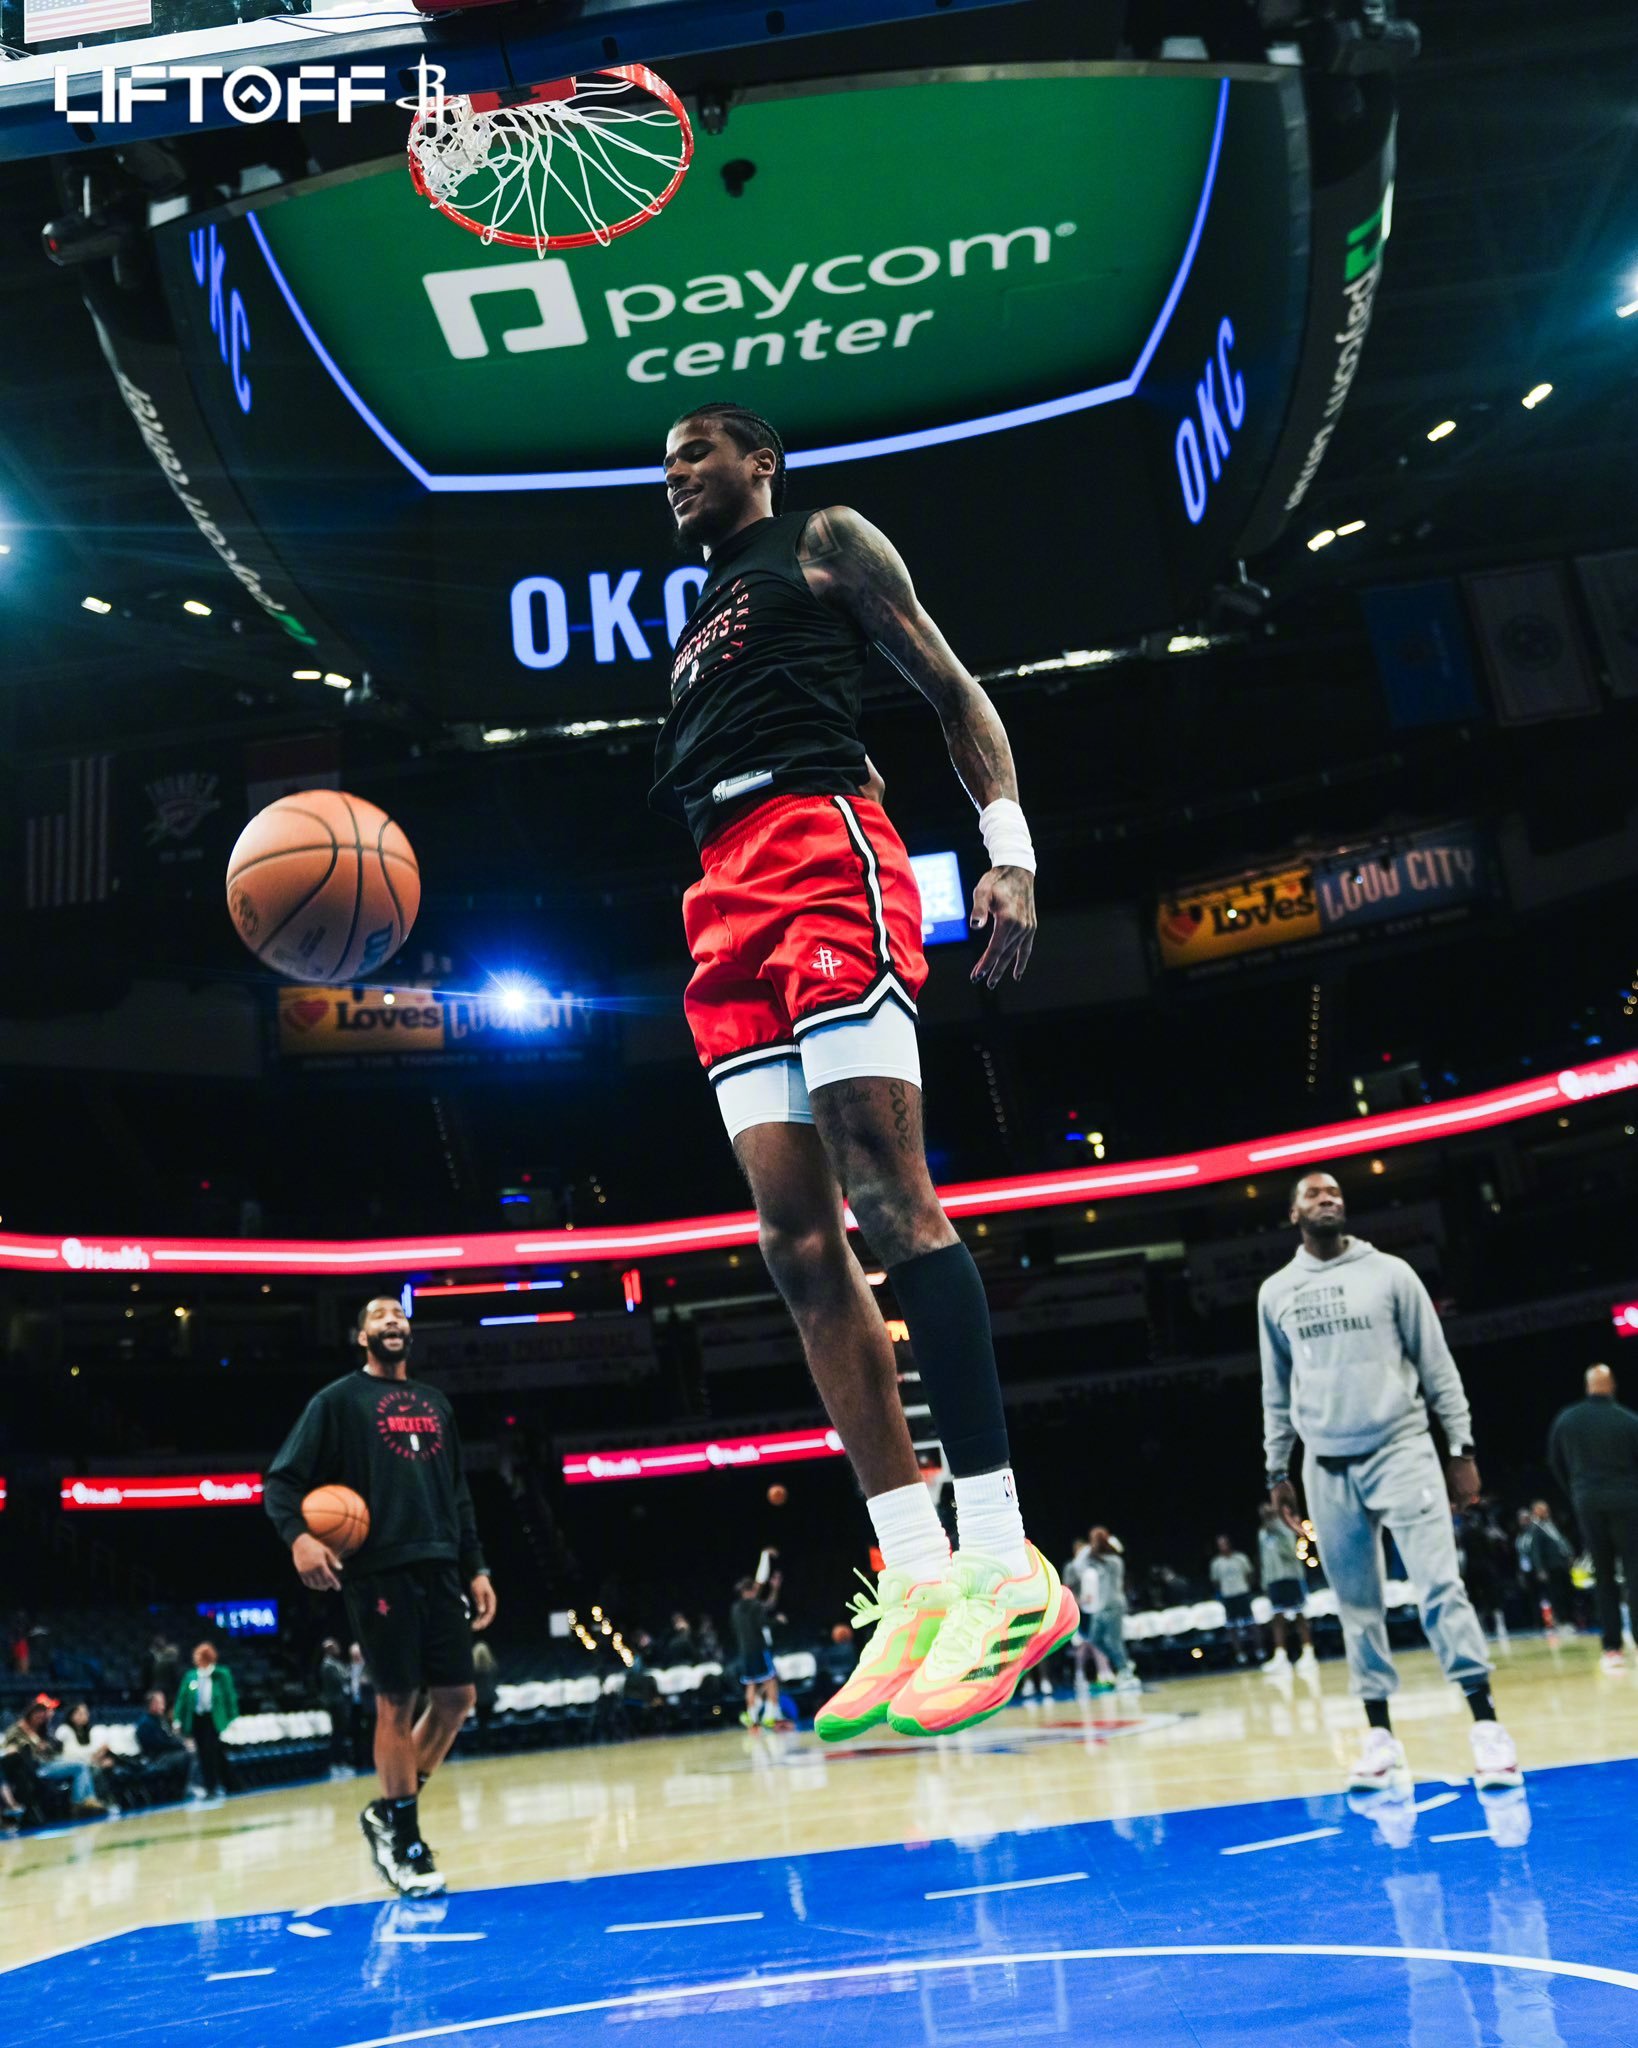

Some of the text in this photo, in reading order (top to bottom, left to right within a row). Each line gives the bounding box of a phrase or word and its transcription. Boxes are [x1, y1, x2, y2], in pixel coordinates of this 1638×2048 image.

[626, 309, 935, 384] center
[1323, 261, 1382, 419] paycom
[1175, 314, 1246, 524] OKC
[1404, 846, 1476, 891] CITY
[1298, 1315, 1373, 1341] BASKETBALL
